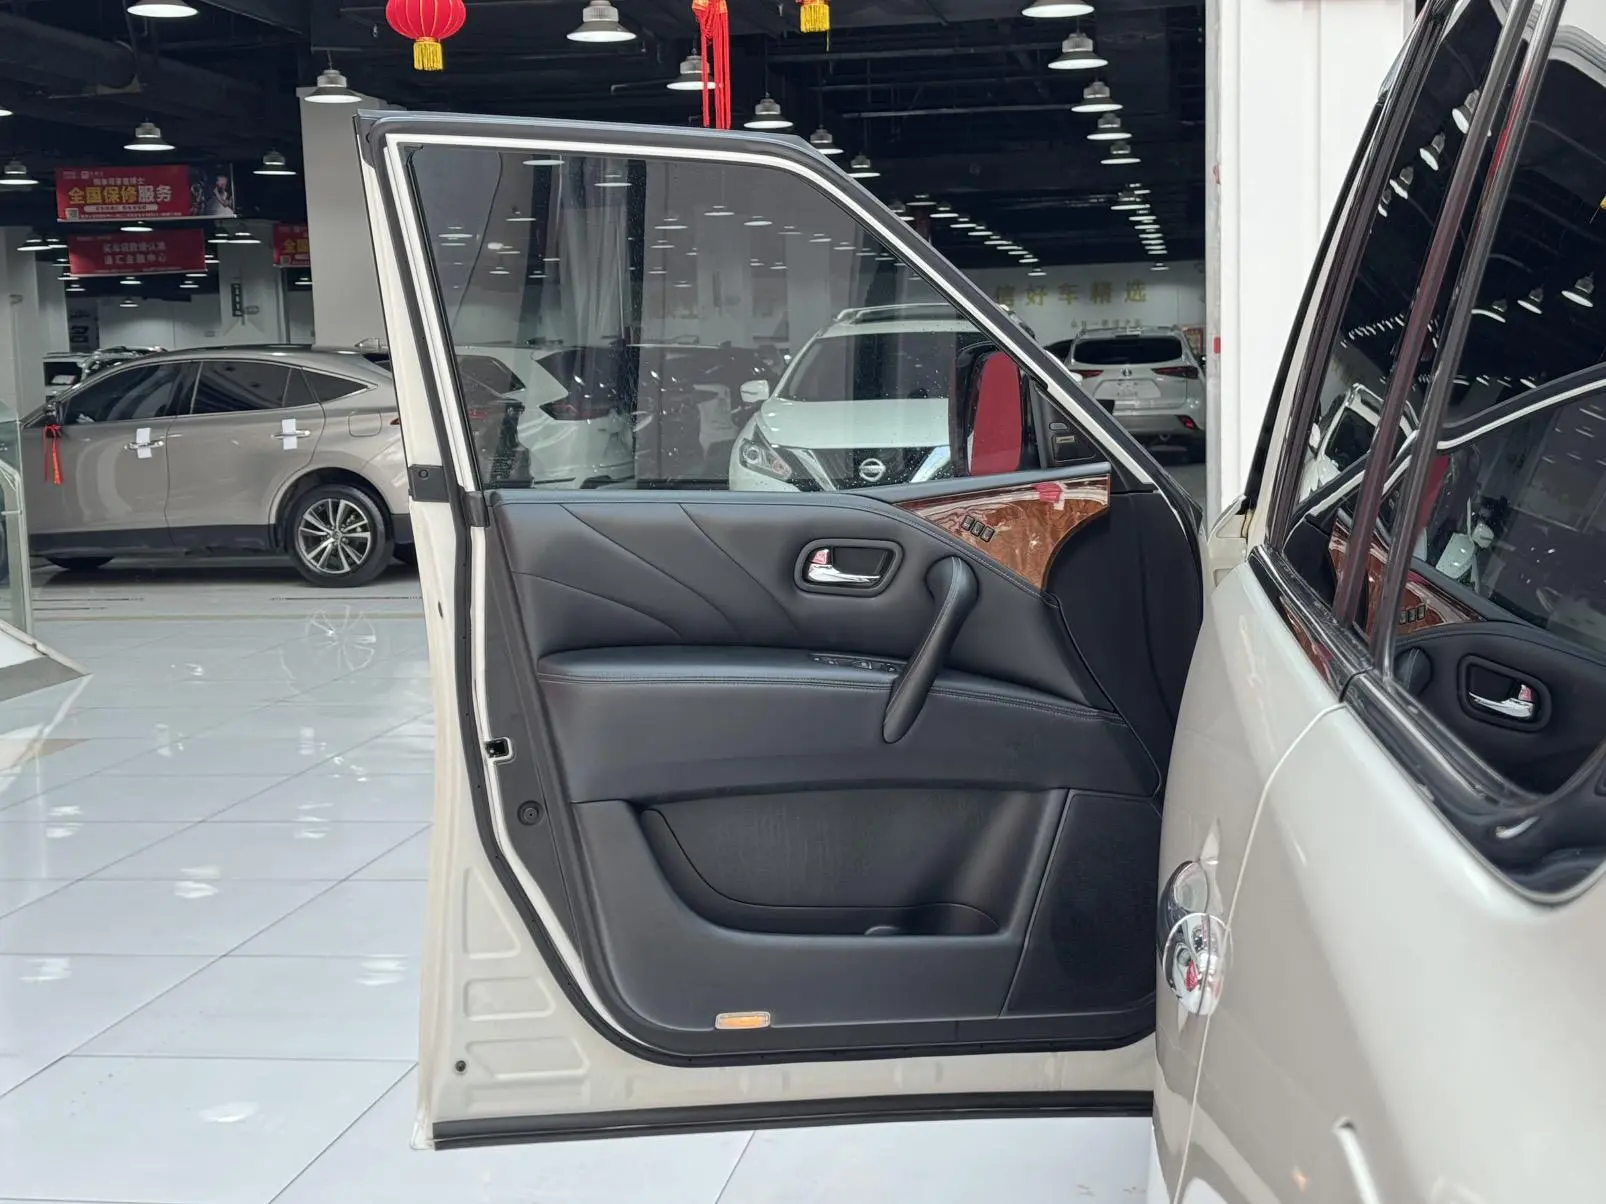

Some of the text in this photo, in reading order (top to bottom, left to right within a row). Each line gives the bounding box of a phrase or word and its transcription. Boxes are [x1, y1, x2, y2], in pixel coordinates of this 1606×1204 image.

[68, 184, 172, 204] 全国保修服务
